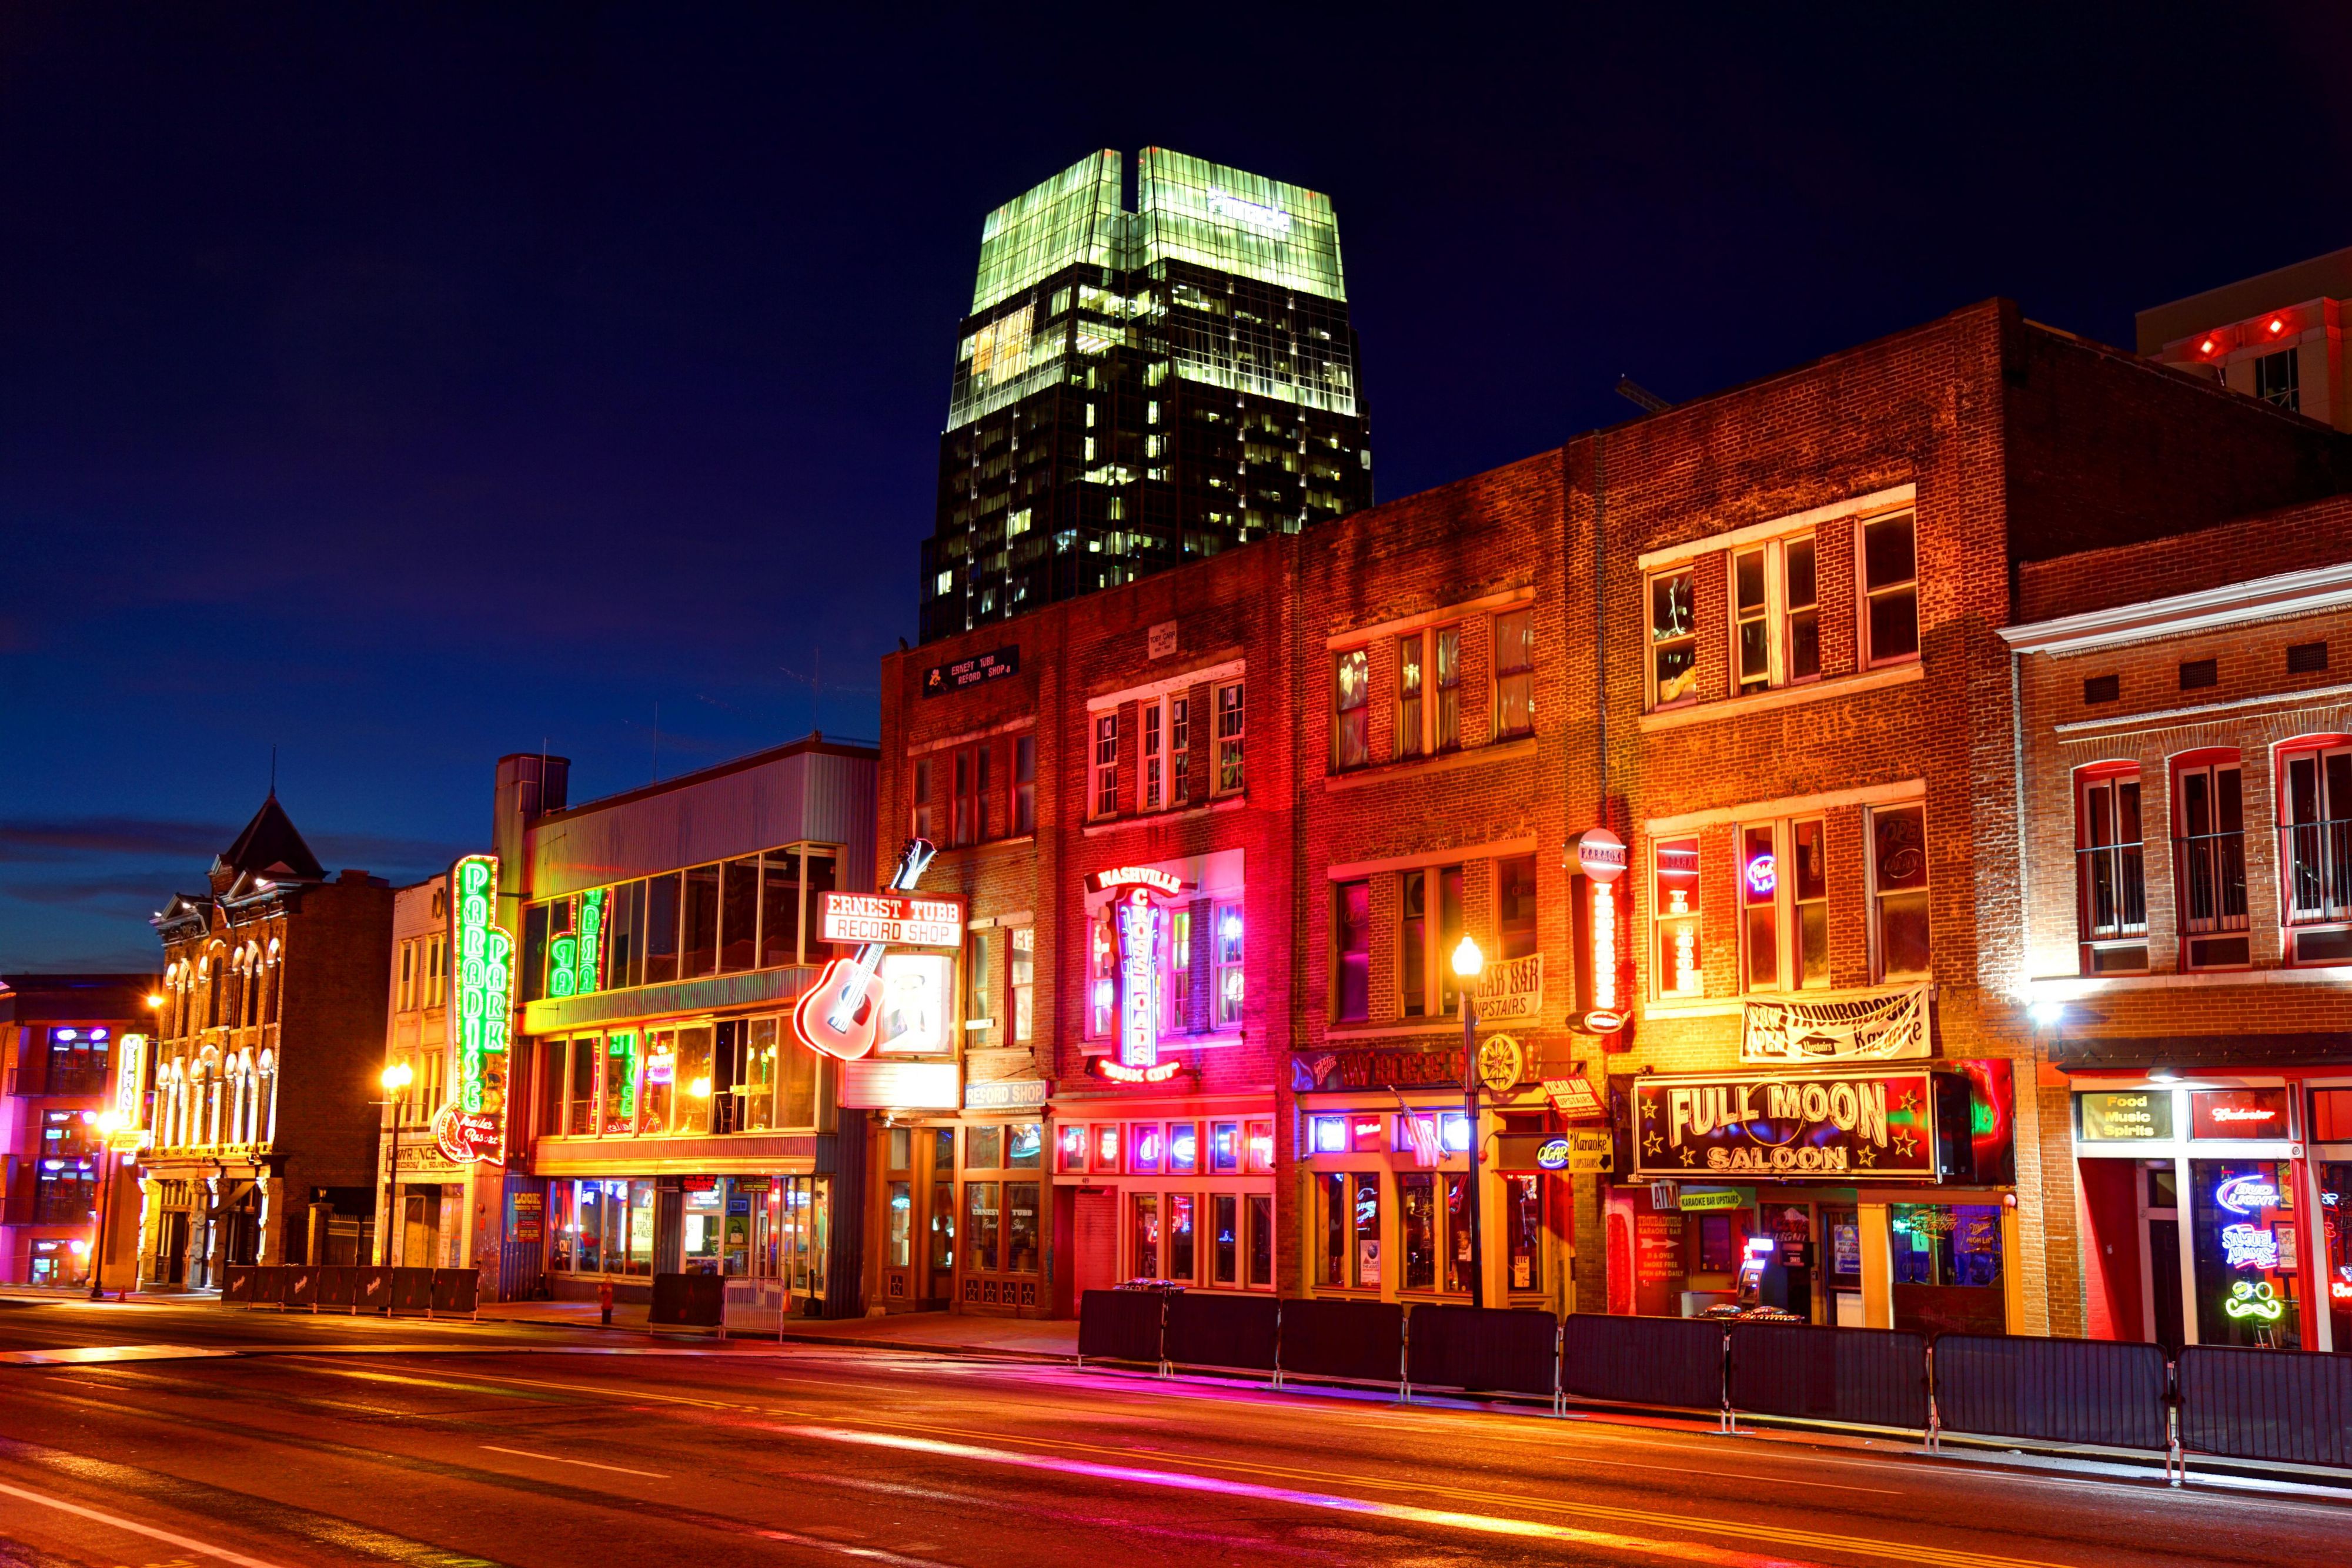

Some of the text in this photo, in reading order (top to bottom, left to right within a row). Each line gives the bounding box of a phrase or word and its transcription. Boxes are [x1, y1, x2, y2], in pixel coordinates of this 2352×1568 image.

[1150, 630, 1175, 644] TOBY CARR
[951, 656, 994, 676] ERNEST TUBB
[958, 671, 981, 685] RECORD
[988, 664, 1004, 677] SHOP
[1581, 848, 1624, 862] KARAOKE
[1098, 867, 1181, 894] NASHVILLE
[828, 894, 958, 923] ERNEST TUBB
[838, 919, 949, 942] RECORD SHOP
[1131, 888, 1148, 1065] CROSSROADS
[1509, 957, 1538, 994] BAR
[462, 864, 488, 1113] PARADISE
[484, 934, 509, 1050] PARK
[1474, 997, 1526, 1017] UPSTAIRS
[1748, 1005, 1783, 1028] NOW
[1787, 991, 1921, 1028] TROUBADOURS
[1746, 1031, 1786, 1053] OPEN
[1803, 1041, 1832, 1052] Upstairs
[1853, 1021, 1922, 1055] Karaoke
[966, 1085, 1043, 1104] RECORD SHOP
[1543, 1079, 1592, 1095] CIGAR BAR
[1558, 1096, 1594, 1106] UPSTAIRS
[2107, 1096, 2147, 1107] Food
[460, 1114, 495, 1130] Trailer
[1668, 1082, 1888, 1148] FULL MOON
[2105, 1112, 2151, 1123] Music
[2212, 1108, 2275, 1122] Budweiser
[465, 1128, 499, 1145] Resort
[2103, 1125, 2154, 1138] Spirits
[1573, 1131, 1607, 1152] Karaoke
[1574, 1158, 1599, 1168] UPSTAIRS
[1707, 1146, 1850, 1172] SALOON
[1655, 1185, 1676, 1208] ATM
[2235, 1182, 2274, 1195] BUD
[514, 1193, 540, 1204] LOOK
[1682, 1197, 1706, 1207] KARAOKE
[1716, 1195, 1739, 1205] UPSTAIRS
[2227, 1195, 2280, 1206] LIGHT
[1011, 1219, 1025, 1232] Shop
[1638, 1216, 1682, 1227] TROUBADOURS
[2222, 1231, 2277, 1250] SAMUEL
[2226, 1247, 2278, 1265] ADAMS
